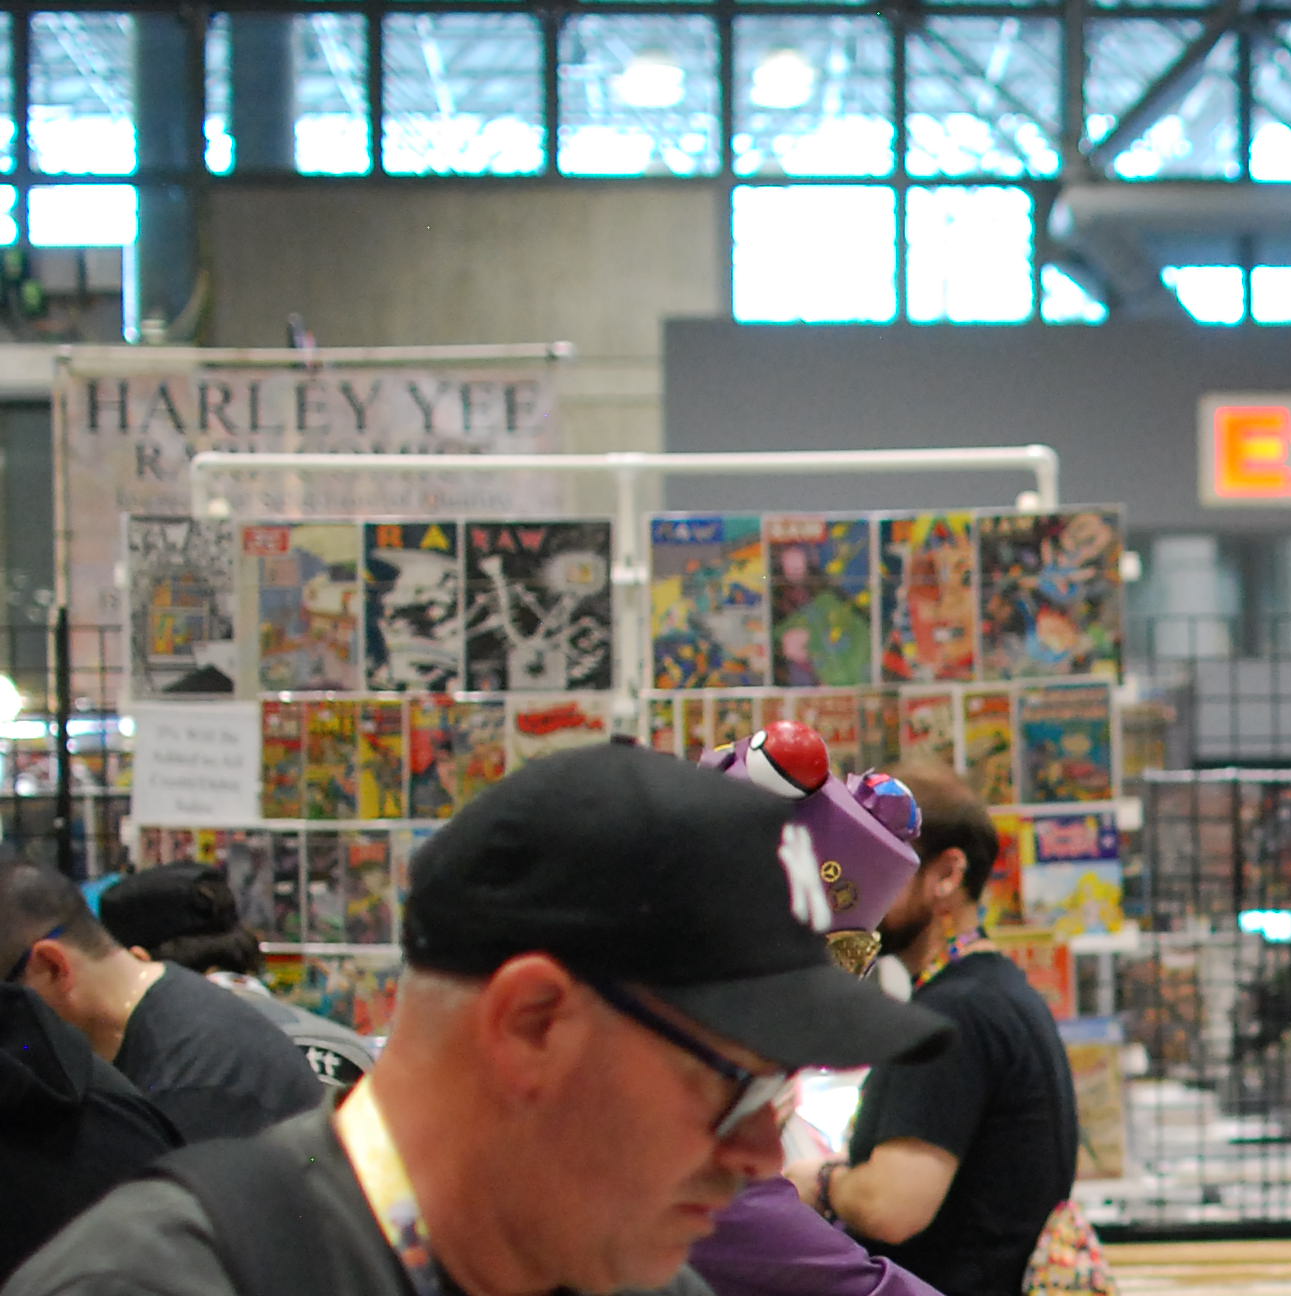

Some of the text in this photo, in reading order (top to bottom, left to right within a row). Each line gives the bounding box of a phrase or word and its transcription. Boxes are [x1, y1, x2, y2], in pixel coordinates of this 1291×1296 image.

[85, 379, 546, 436] HARLEY YEE
[471, 526, 547, 552] RAW
